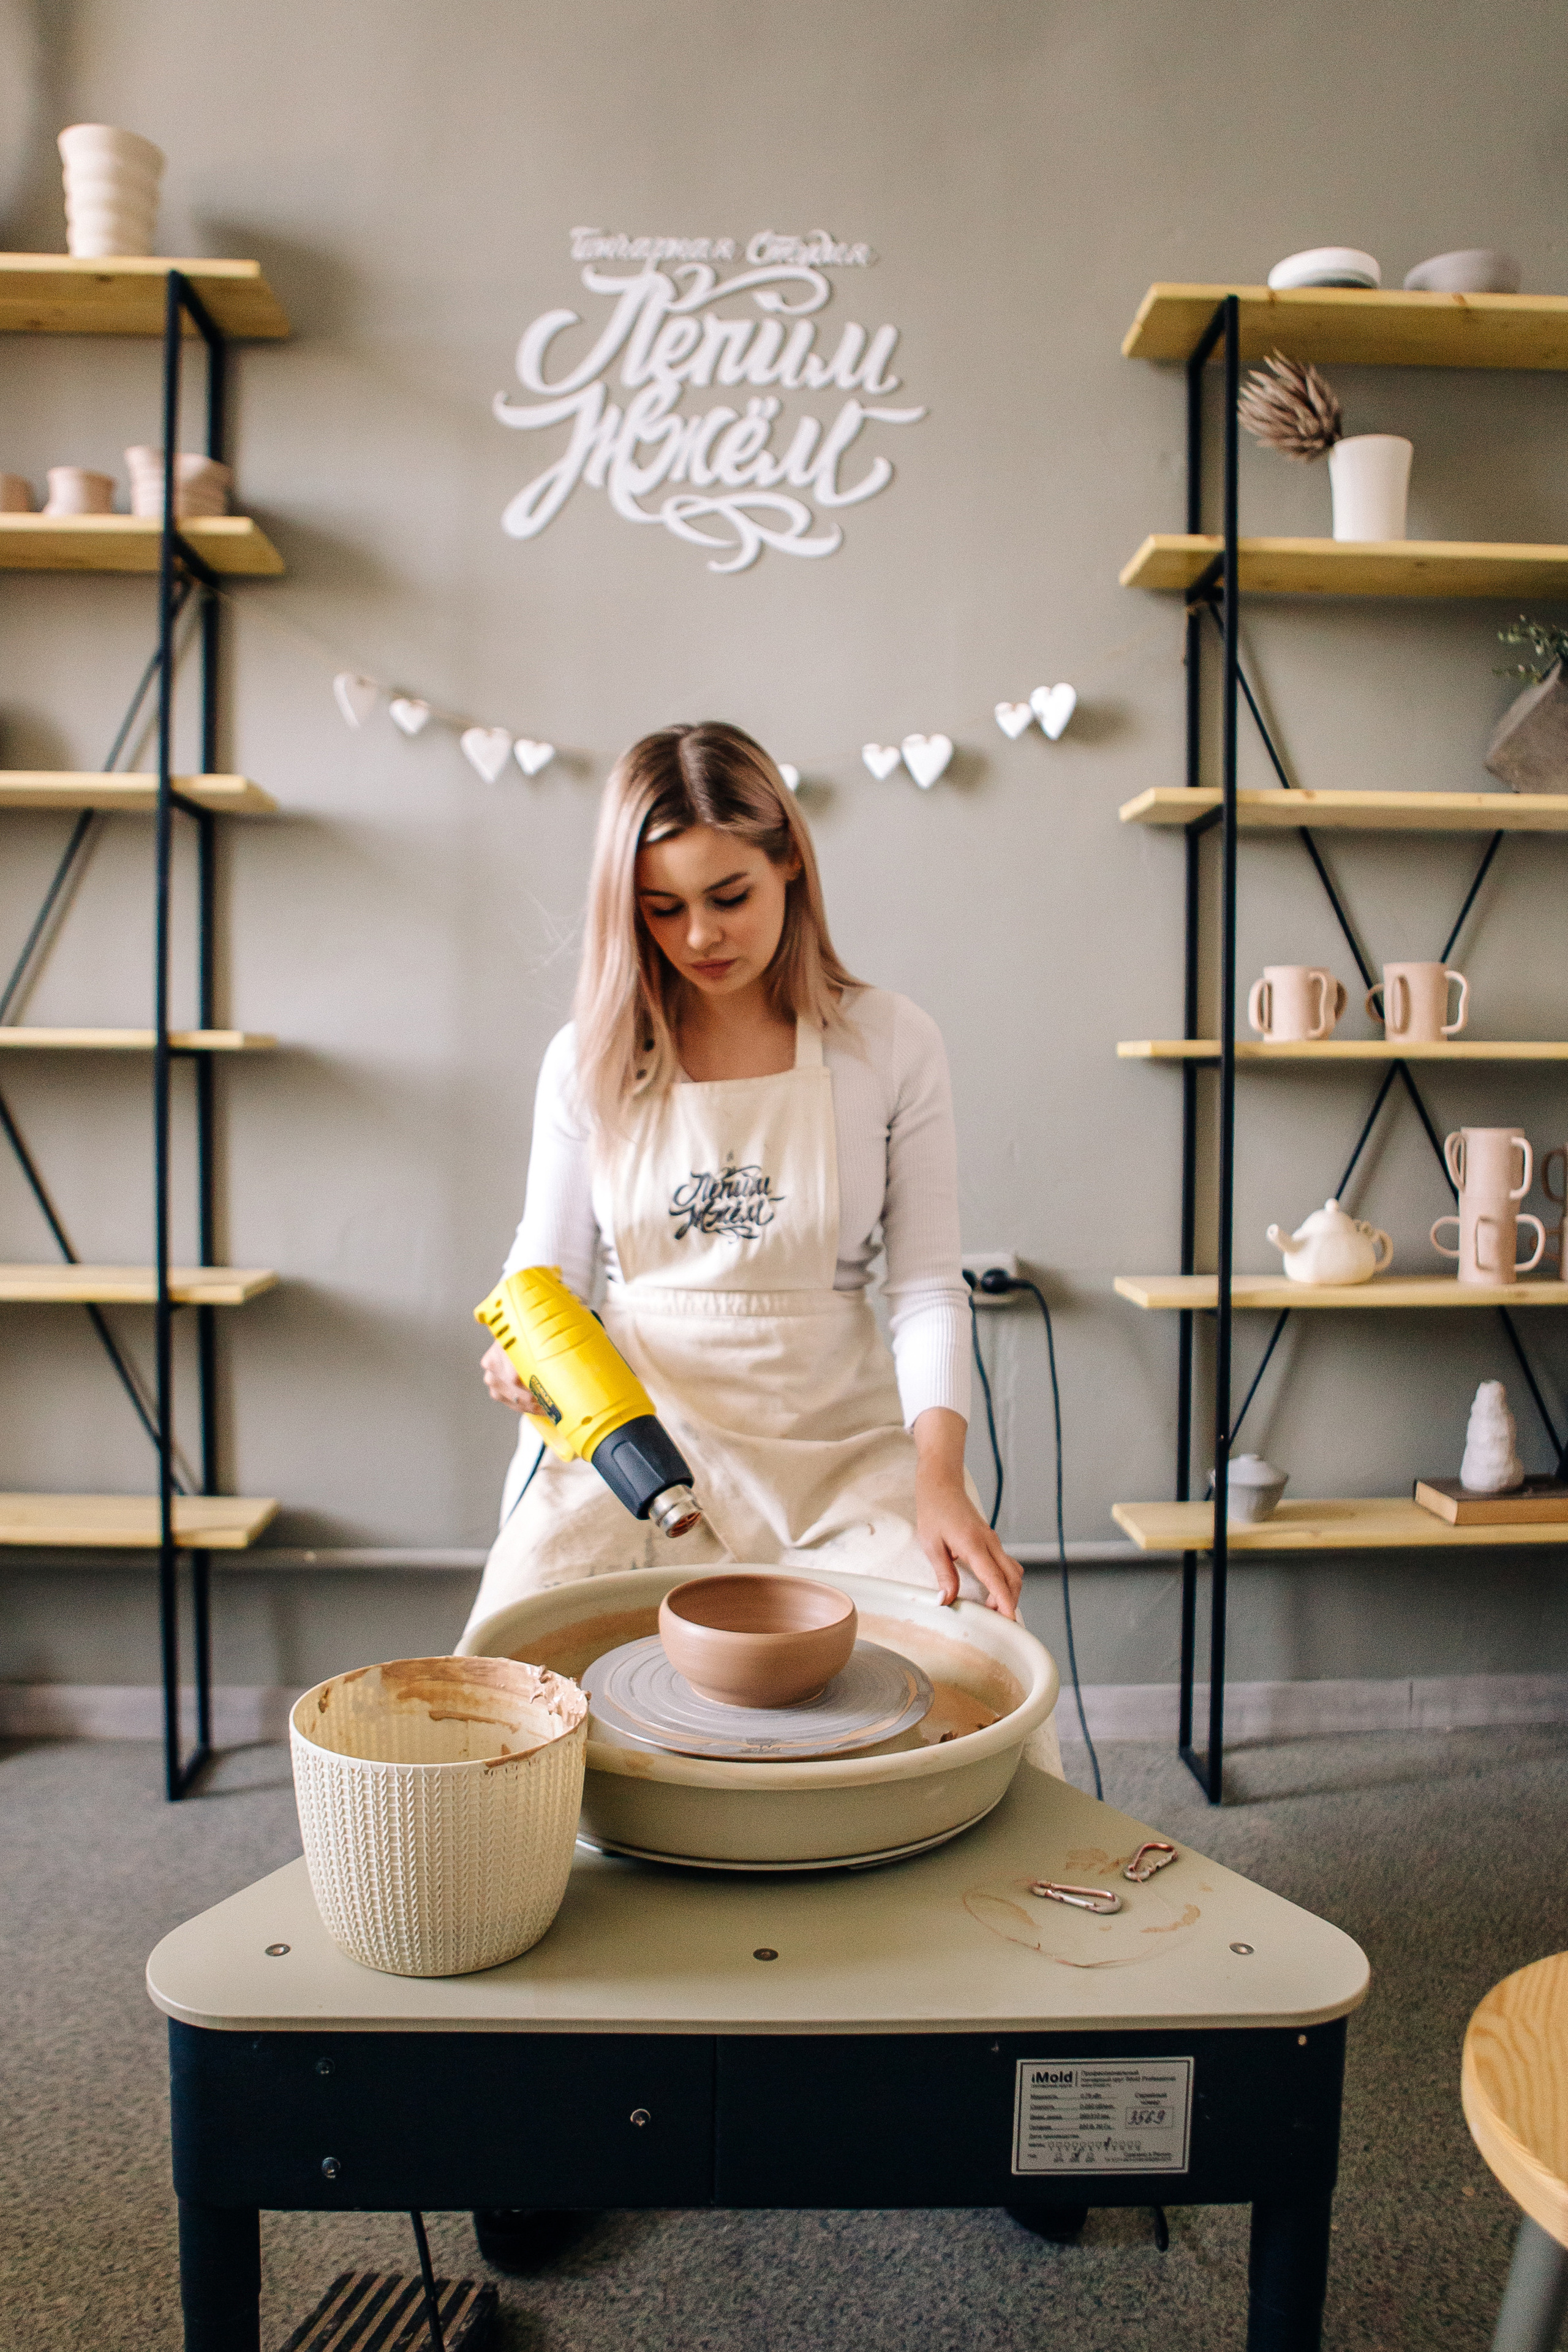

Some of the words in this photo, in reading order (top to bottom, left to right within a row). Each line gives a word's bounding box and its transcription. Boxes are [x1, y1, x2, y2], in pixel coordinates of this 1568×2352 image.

[515, 260, 903, 396] Лепим
[673, 1164, 772, 1207] Лепим
[1031, 2071, 1072, 2083] iMold
[1128, 2109, 1166, 2125] 3569
